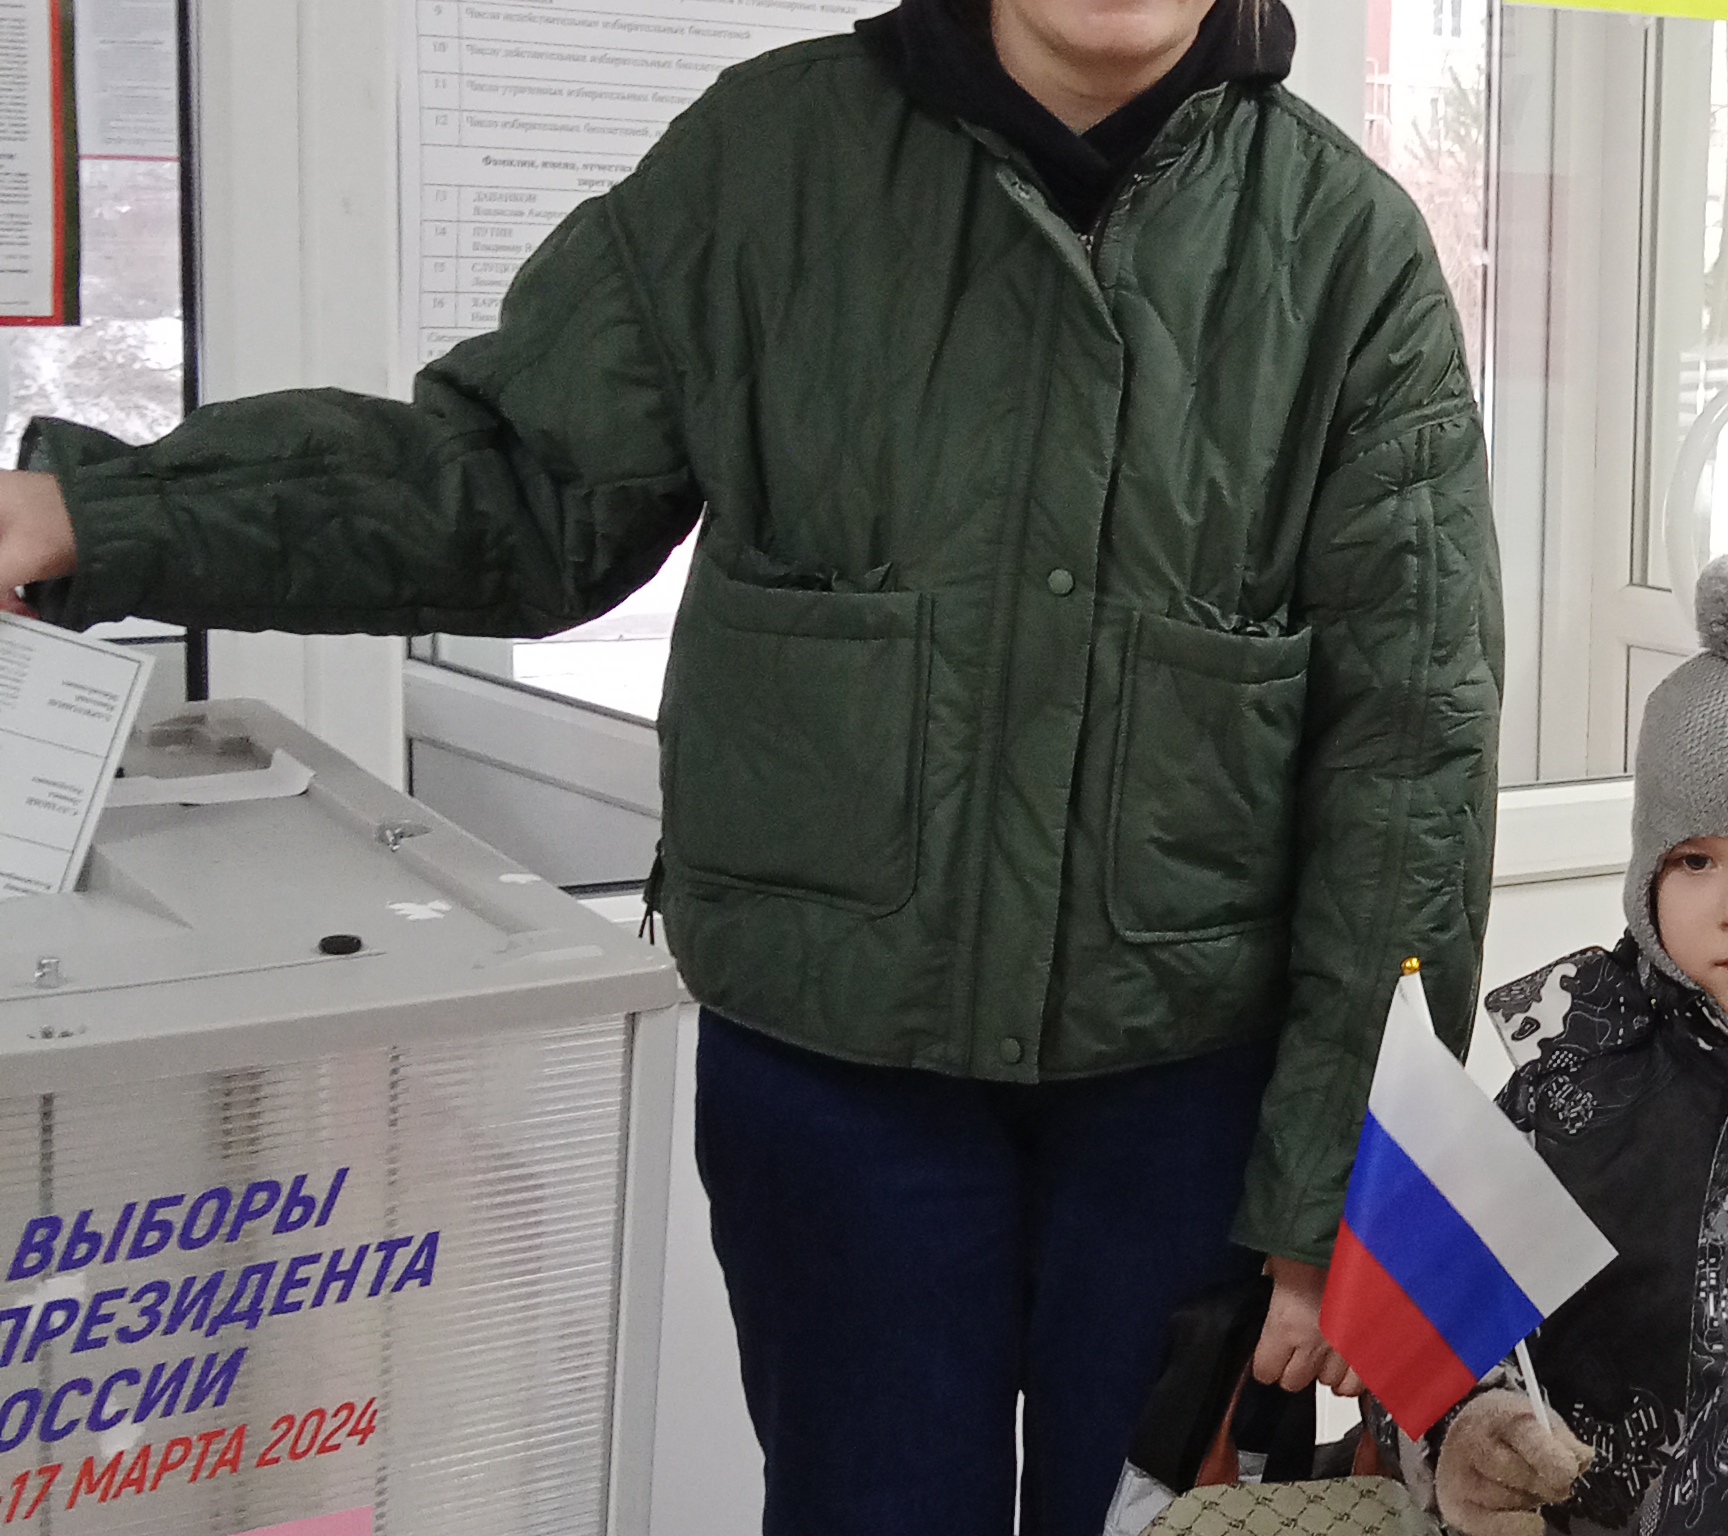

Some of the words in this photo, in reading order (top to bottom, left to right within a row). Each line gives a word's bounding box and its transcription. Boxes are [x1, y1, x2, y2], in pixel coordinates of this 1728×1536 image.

[6, 1167, 350, 1282] ВЫБОРЫ
[0, 1347, 248, 1454] ОССИИ
[0, 1464, 62, 1524] 17
[64, 1423, 247, 1511] МАРТА
[255, 1396, 377, 1469] 2024
